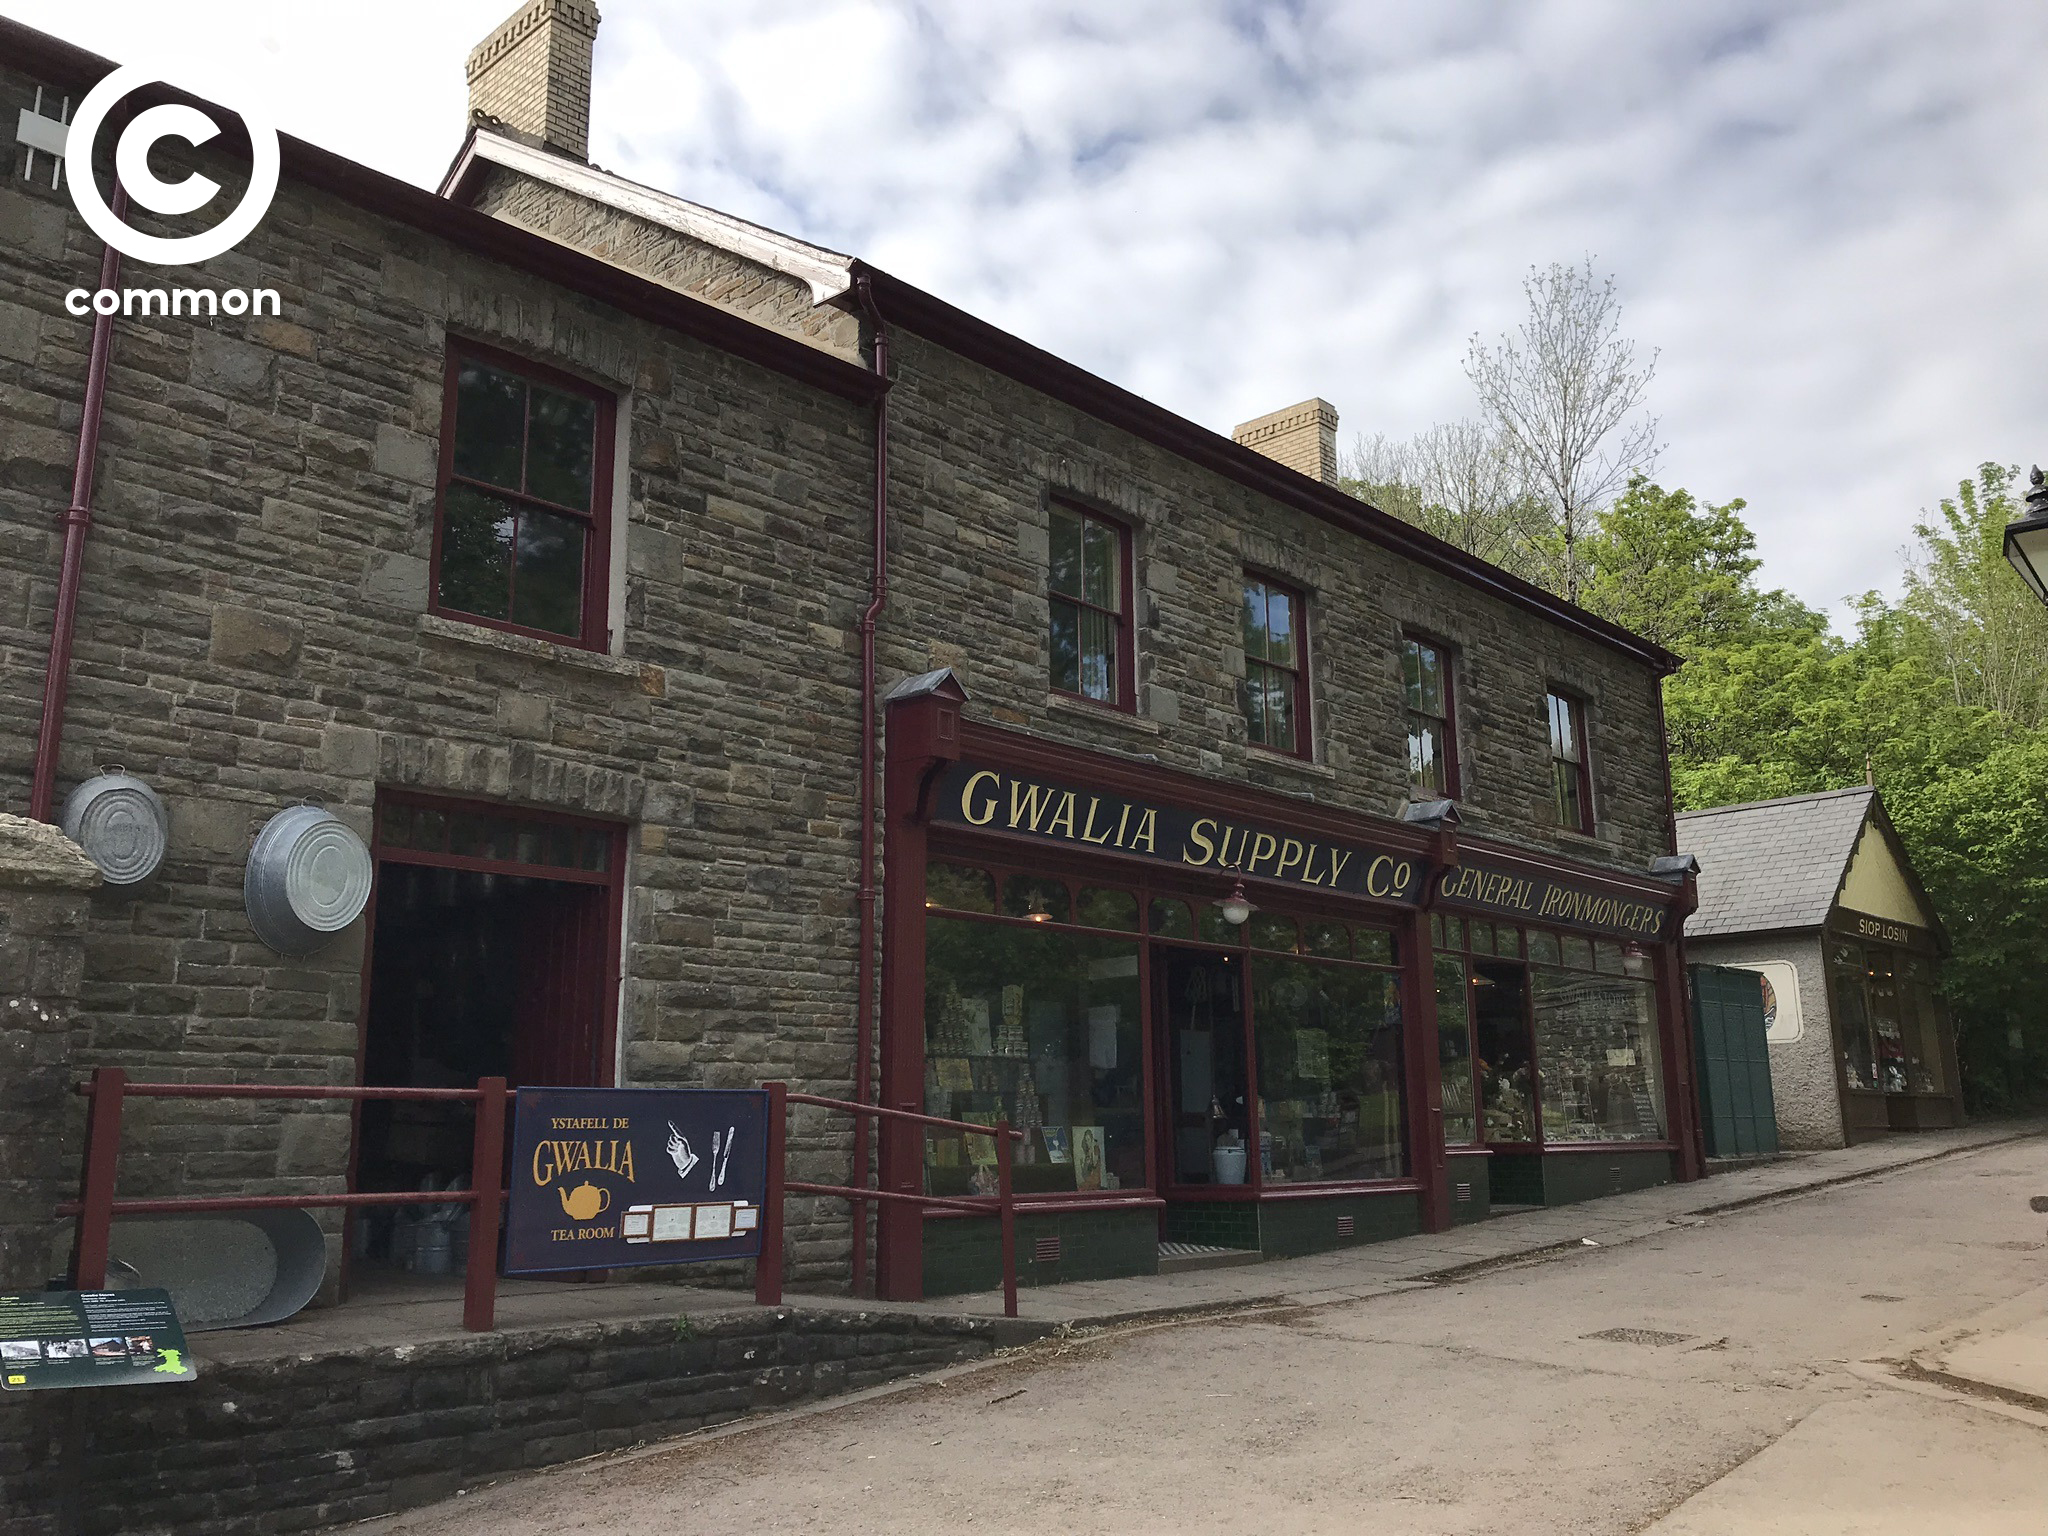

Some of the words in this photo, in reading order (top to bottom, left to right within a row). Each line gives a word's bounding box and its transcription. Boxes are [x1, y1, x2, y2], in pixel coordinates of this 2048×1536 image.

[960, 770, 1158, 854] GWALIA
[1182, 817, 1353, 888] SUPPLY
[1440, 864, 1534, 911] GENERAL
[1537, 883, 1665, 935] IRONMONGERS
[1859, 918, 1881, 937] SIOP
[1882, 924, 1908, 943] LOSIN
[551, 1117, 609, 1130] YSTAFELL
[613, 1118, 630, 1129] DE
[532, 1139, 636, 1187] GWALIA
[551, 1229, 575, 1242] TEA
[578, 1226, 614, 1240] ROOM
